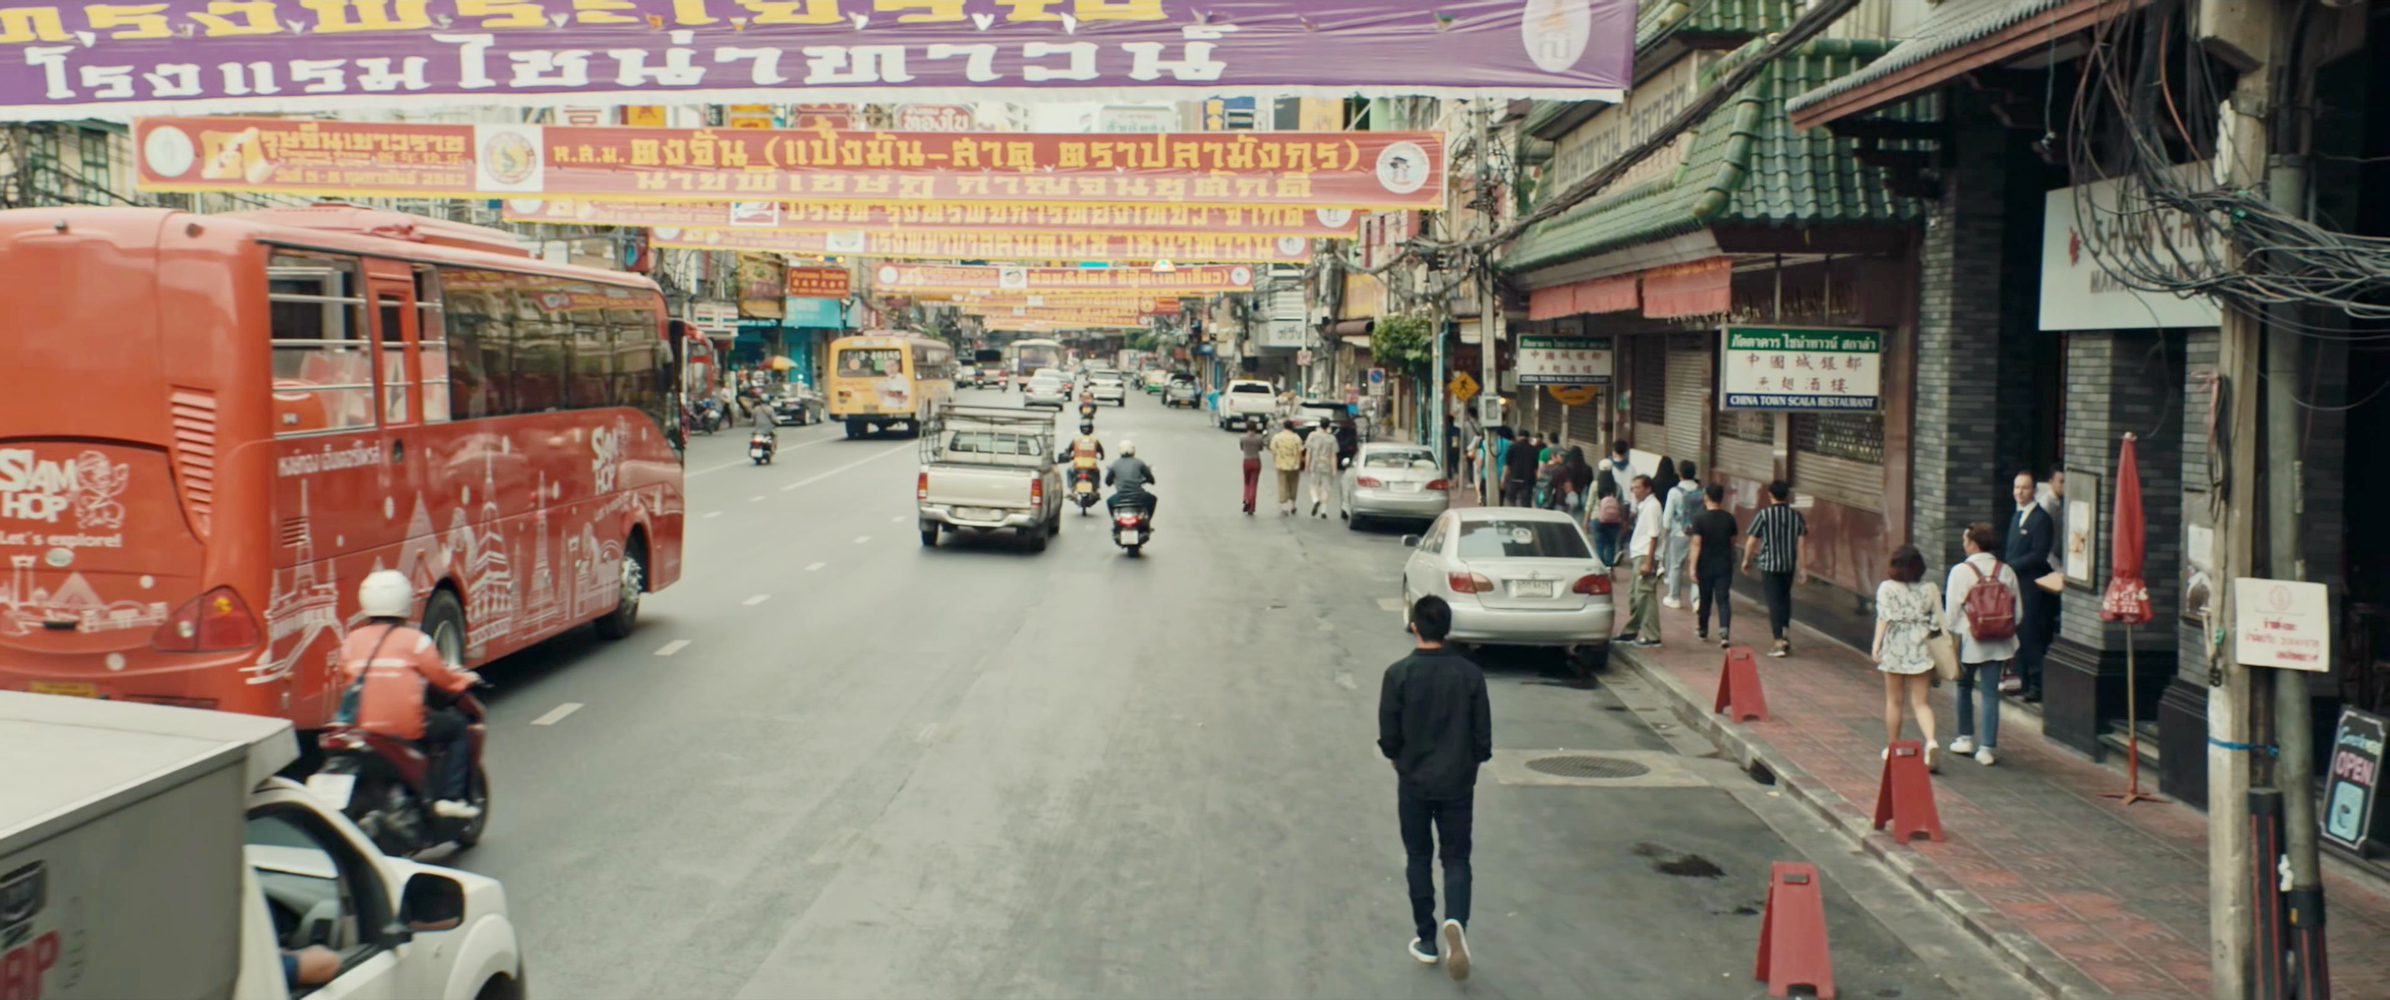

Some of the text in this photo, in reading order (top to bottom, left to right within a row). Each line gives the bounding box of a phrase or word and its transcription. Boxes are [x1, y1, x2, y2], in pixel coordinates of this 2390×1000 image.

[1730, 396, 1874, 408] CHINA TOWN SCALA RESTAURANT
[0, 449, 80, 496] SIAM
[2, 492, 68, 523] HOP
[46, 532, 123, 548] explore!
[2334, 750, 2374, 786] OPEN
